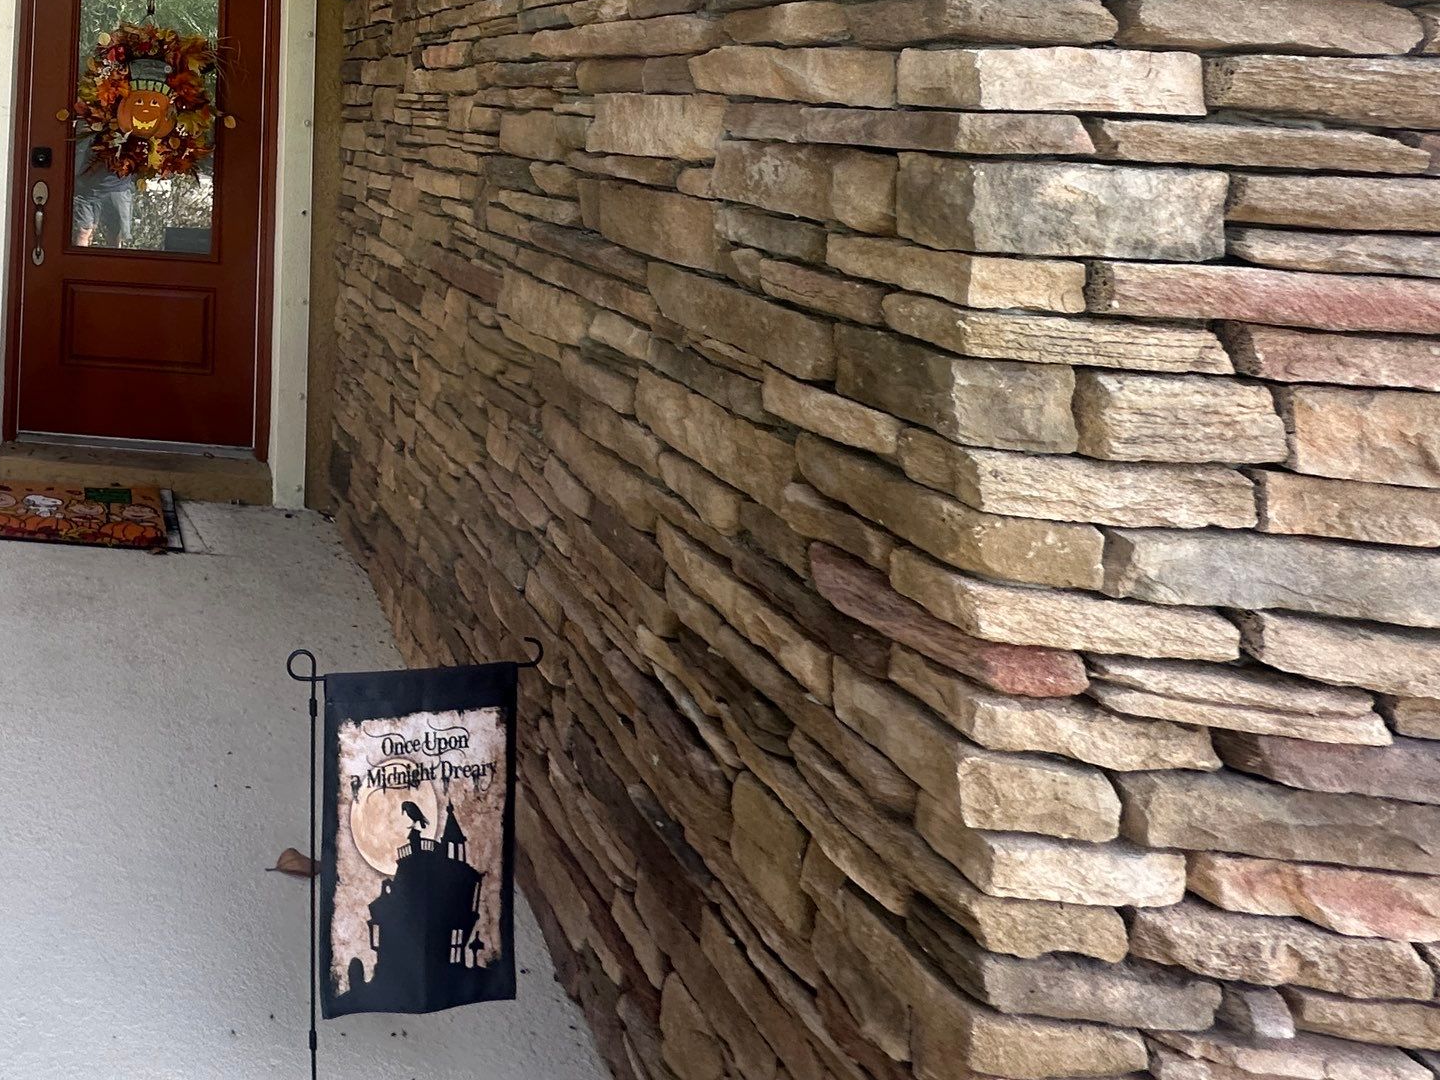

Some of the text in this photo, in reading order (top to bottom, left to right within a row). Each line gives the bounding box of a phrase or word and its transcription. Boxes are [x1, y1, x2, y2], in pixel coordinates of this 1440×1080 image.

[378, 728, 470, 757] Once Upon
[350, 760, 498, 797] a Midnight Dreary
